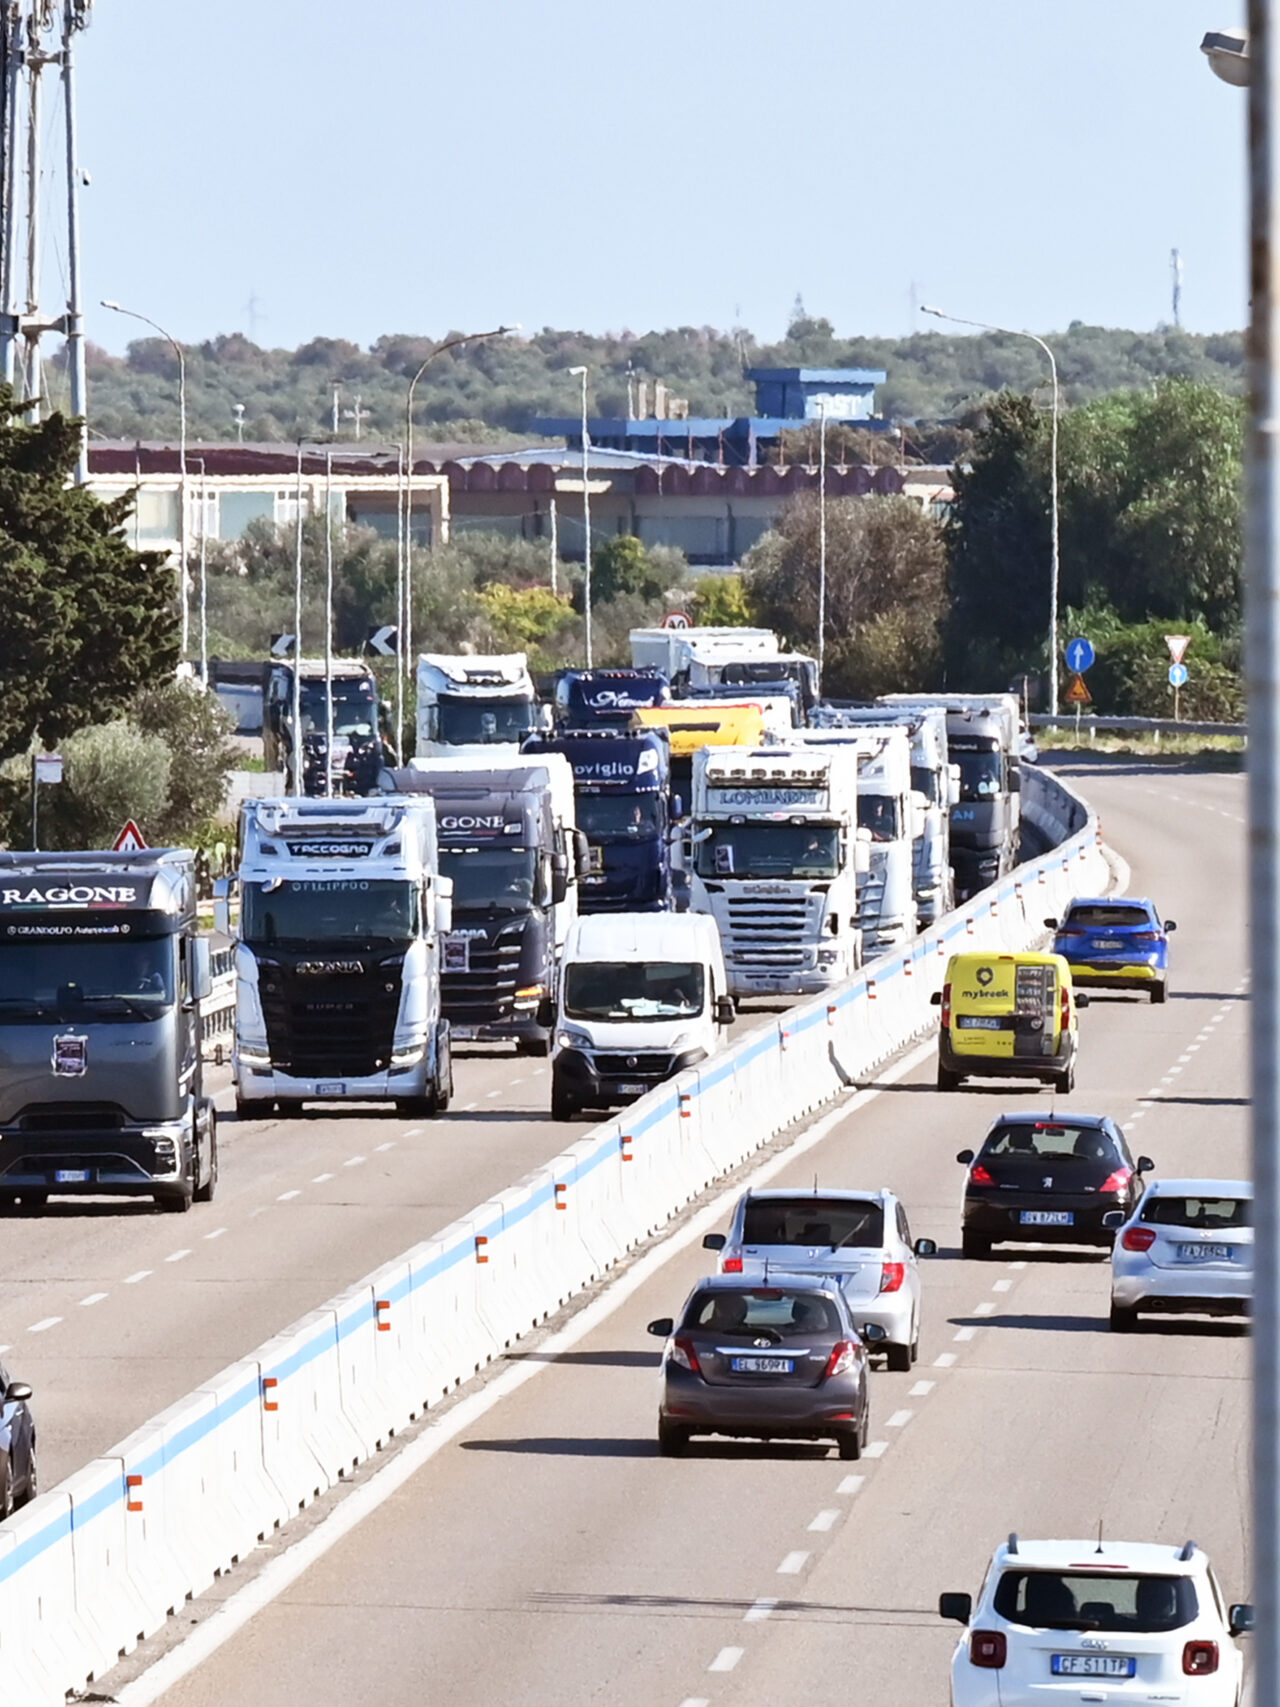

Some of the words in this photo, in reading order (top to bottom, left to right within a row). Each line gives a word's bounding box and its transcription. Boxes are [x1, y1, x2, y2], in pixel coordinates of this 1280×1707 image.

[575, 762, 634, 776] oviglio
[952, 810, 976, 820] AN
[438, 816, 504, 828] GONE
[292, 844, 369, 854] TACCOGNA
[2, 886, 136, 904] RAGONE
[962, 989, 1009, 999] mybreak
